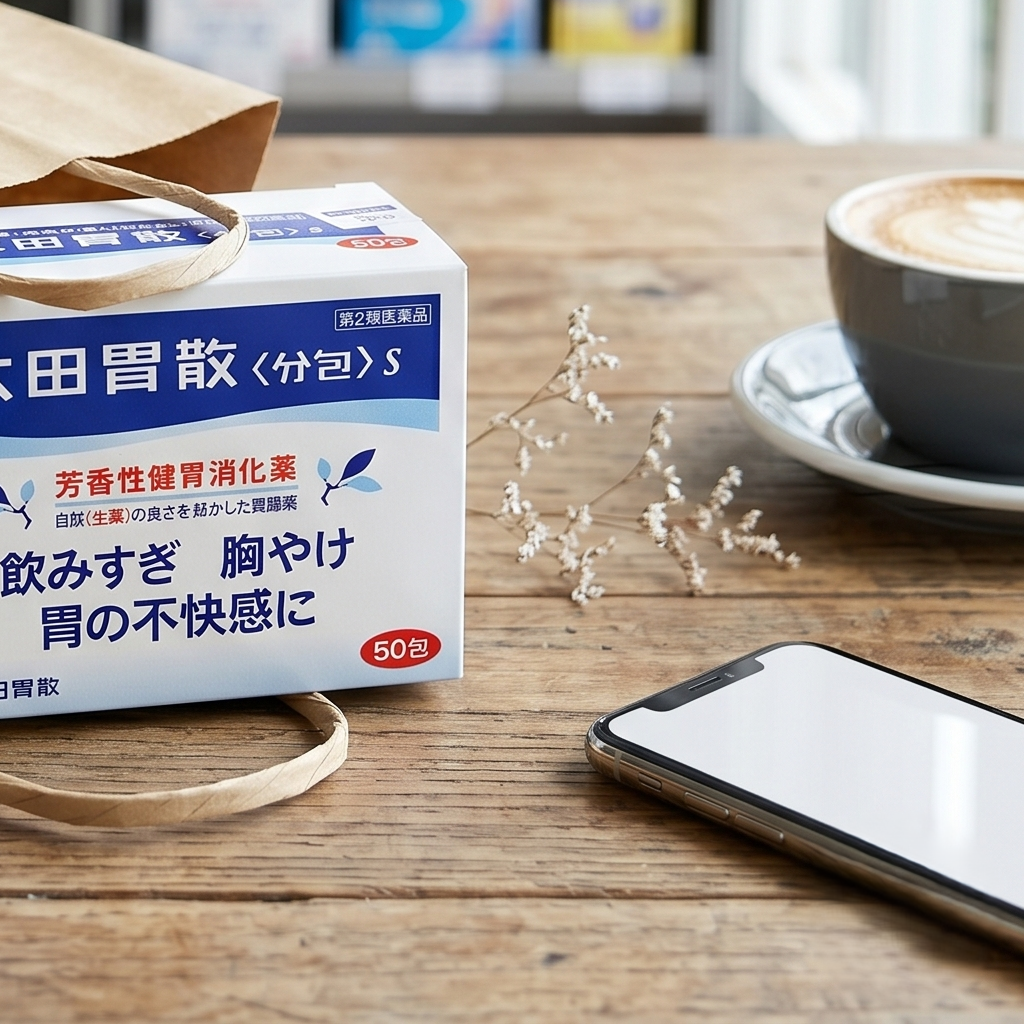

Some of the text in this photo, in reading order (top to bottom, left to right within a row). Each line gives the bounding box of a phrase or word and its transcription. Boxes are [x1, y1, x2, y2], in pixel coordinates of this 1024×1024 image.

[54, 454, 297, 499] 芳香性健胃消化薬
[0, 527, 355, 598] 飲みすぎ 胸やけ
[41, 589, 317, 651] 胃の不快感に
[372, 637, 429, 662] 50包
